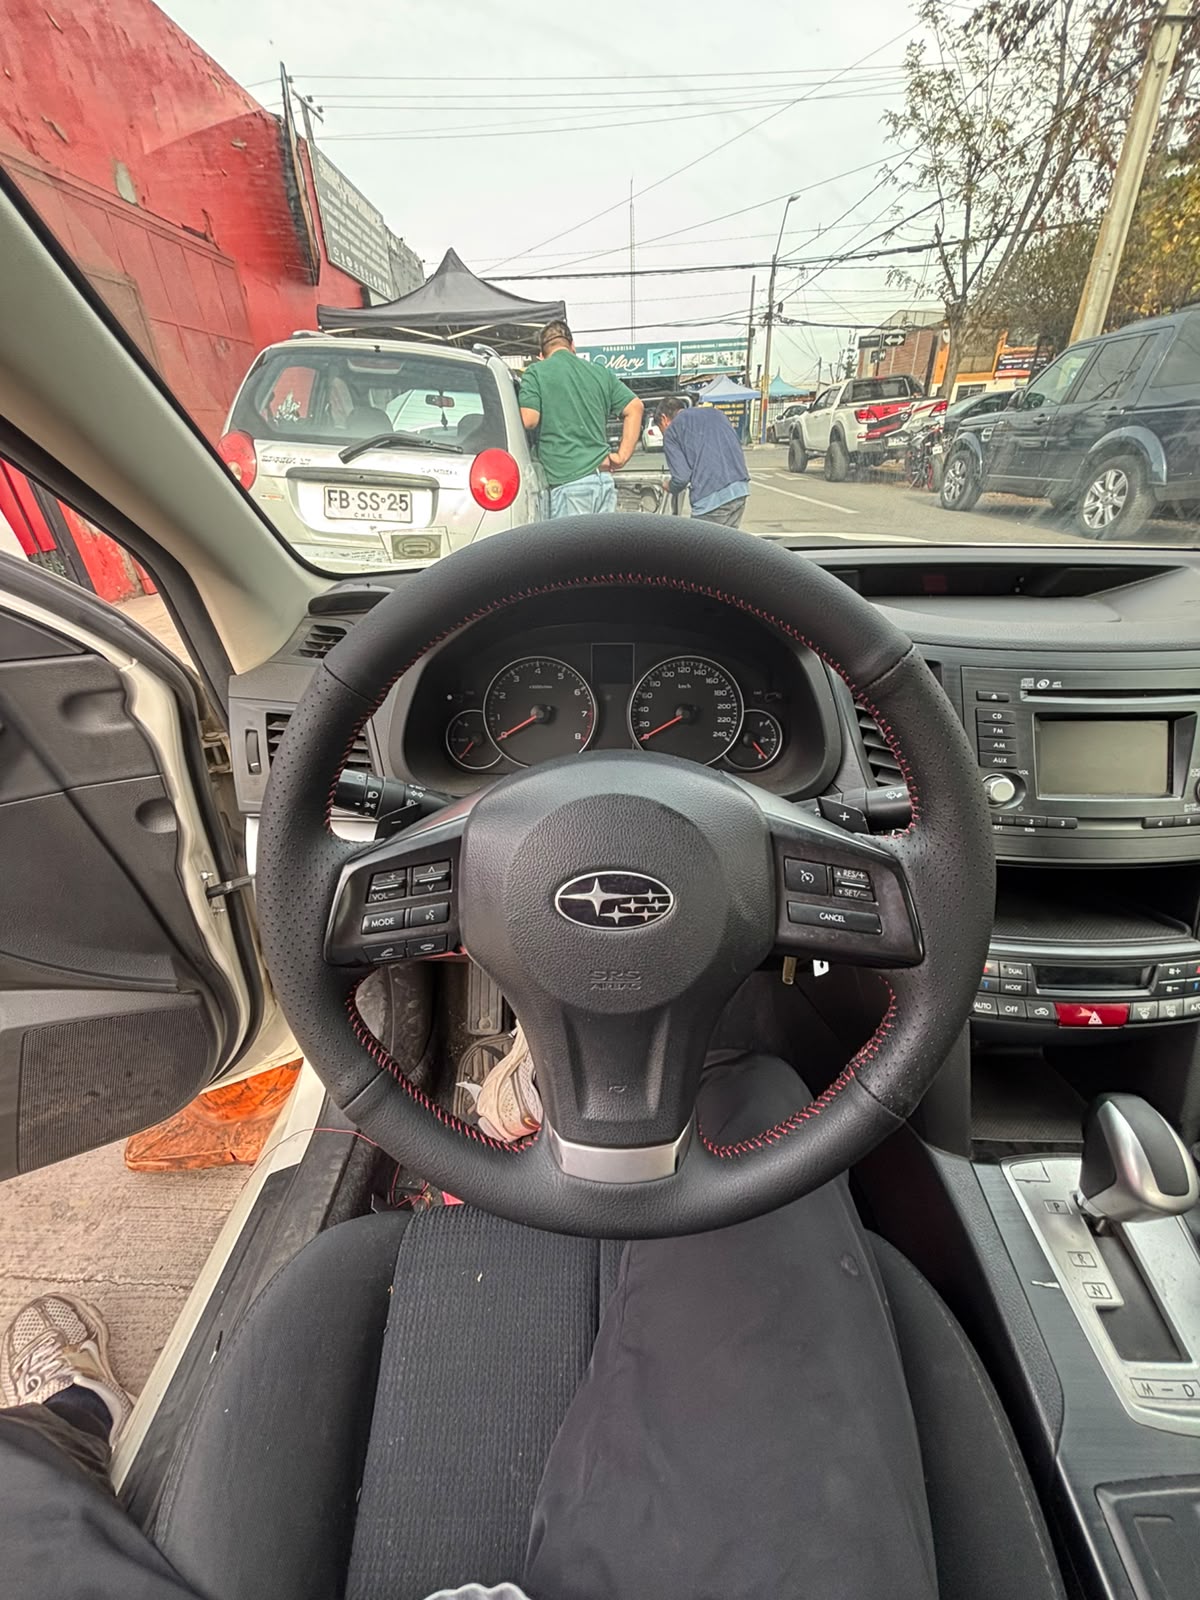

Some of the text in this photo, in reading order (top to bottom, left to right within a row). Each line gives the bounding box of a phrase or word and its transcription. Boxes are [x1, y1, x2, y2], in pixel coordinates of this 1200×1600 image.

[604, 354, 645, 372] Mary
[371, 916, 395, 927] MODE
[819, 912, 846, 923] CANCEL
[590, 970, 641, 981] SRS
[1008, 967, 1023, 975] DUAL
[1005, 983, 1022, 991] MODE
[973, 1001, 992, 1010] AUTO
[1005, 1004, 1018, 1013] OFF
[1141, 1383, 1194, 1397] M D
